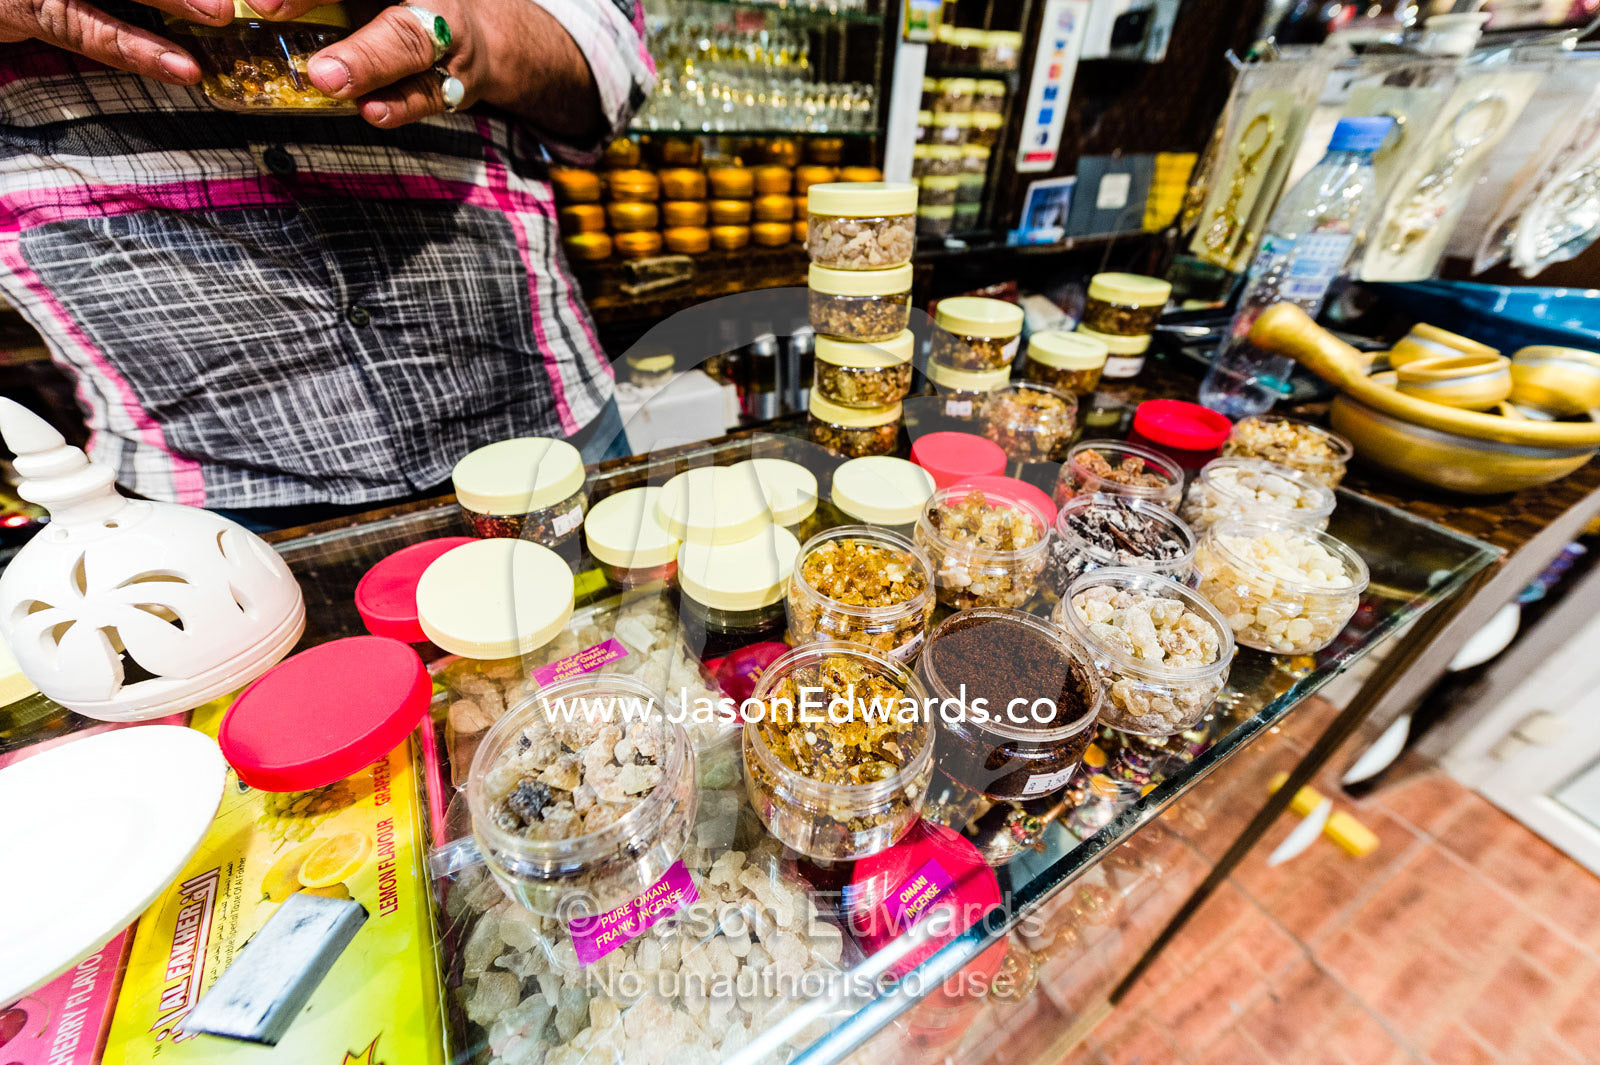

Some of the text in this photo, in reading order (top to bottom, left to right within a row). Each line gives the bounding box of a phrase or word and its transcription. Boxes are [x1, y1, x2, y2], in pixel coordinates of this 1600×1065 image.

[553, 666, 583, 681] FRANK
[583, 651, 618, 669] INCENSE
[555, 661, 580, 673] PURE
[580, 649, 607, 663] OMANI
[374, 754, 392, 807] GRAPE FLA
[235, 856, 247, 879] Fakher
[376, 817, 398, 918] LEMON FLAVOUR
[229, 894, 242, 914] Taste
[233, 885, 242, 895] Of
[601, 881, 670, 928] PURE OMANI
[900, 875, 928, 903] OMANI
[905, 883, 941, 919] INCENSE
[595, 888, 684, 948] FRANK INCENSE
[158, 904, 205, 1011] AL FAKHER
